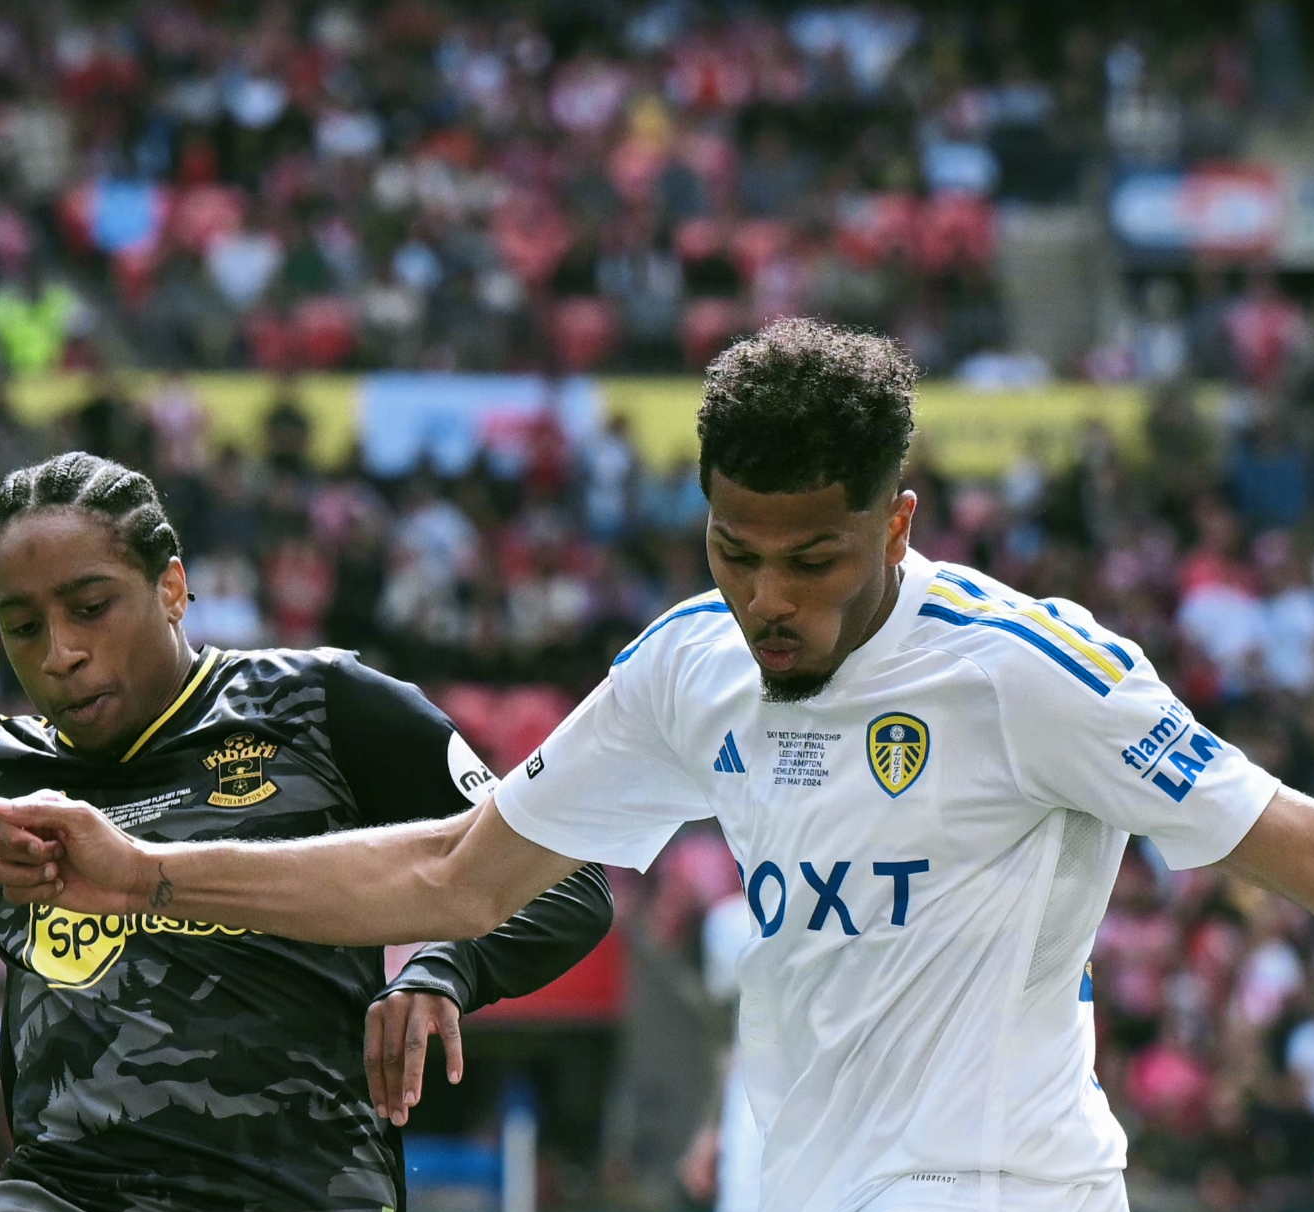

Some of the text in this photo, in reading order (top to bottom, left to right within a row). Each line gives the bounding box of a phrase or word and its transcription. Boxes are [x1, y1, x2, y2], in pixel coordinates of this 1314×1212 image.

[779, 731, 789, 740] BET
[791, 732, 841, 741] CHAMPIONSHIP
[804, 741, 825, 750] FINAL
[798, 768, 829, 777] STADIUM
[787, 778, 801, 786] MAY
[802, 778, 822, 787] 2024
[152, 791, 176, 804] PLAY-OFF
[176, 787, 191, 797] FINAL
[211, 785, 272, 804] SOUTHAMPTON FC
[735, 859, 930, 939] OXT
[910, 1174, 957, 1184] AEROREADY
